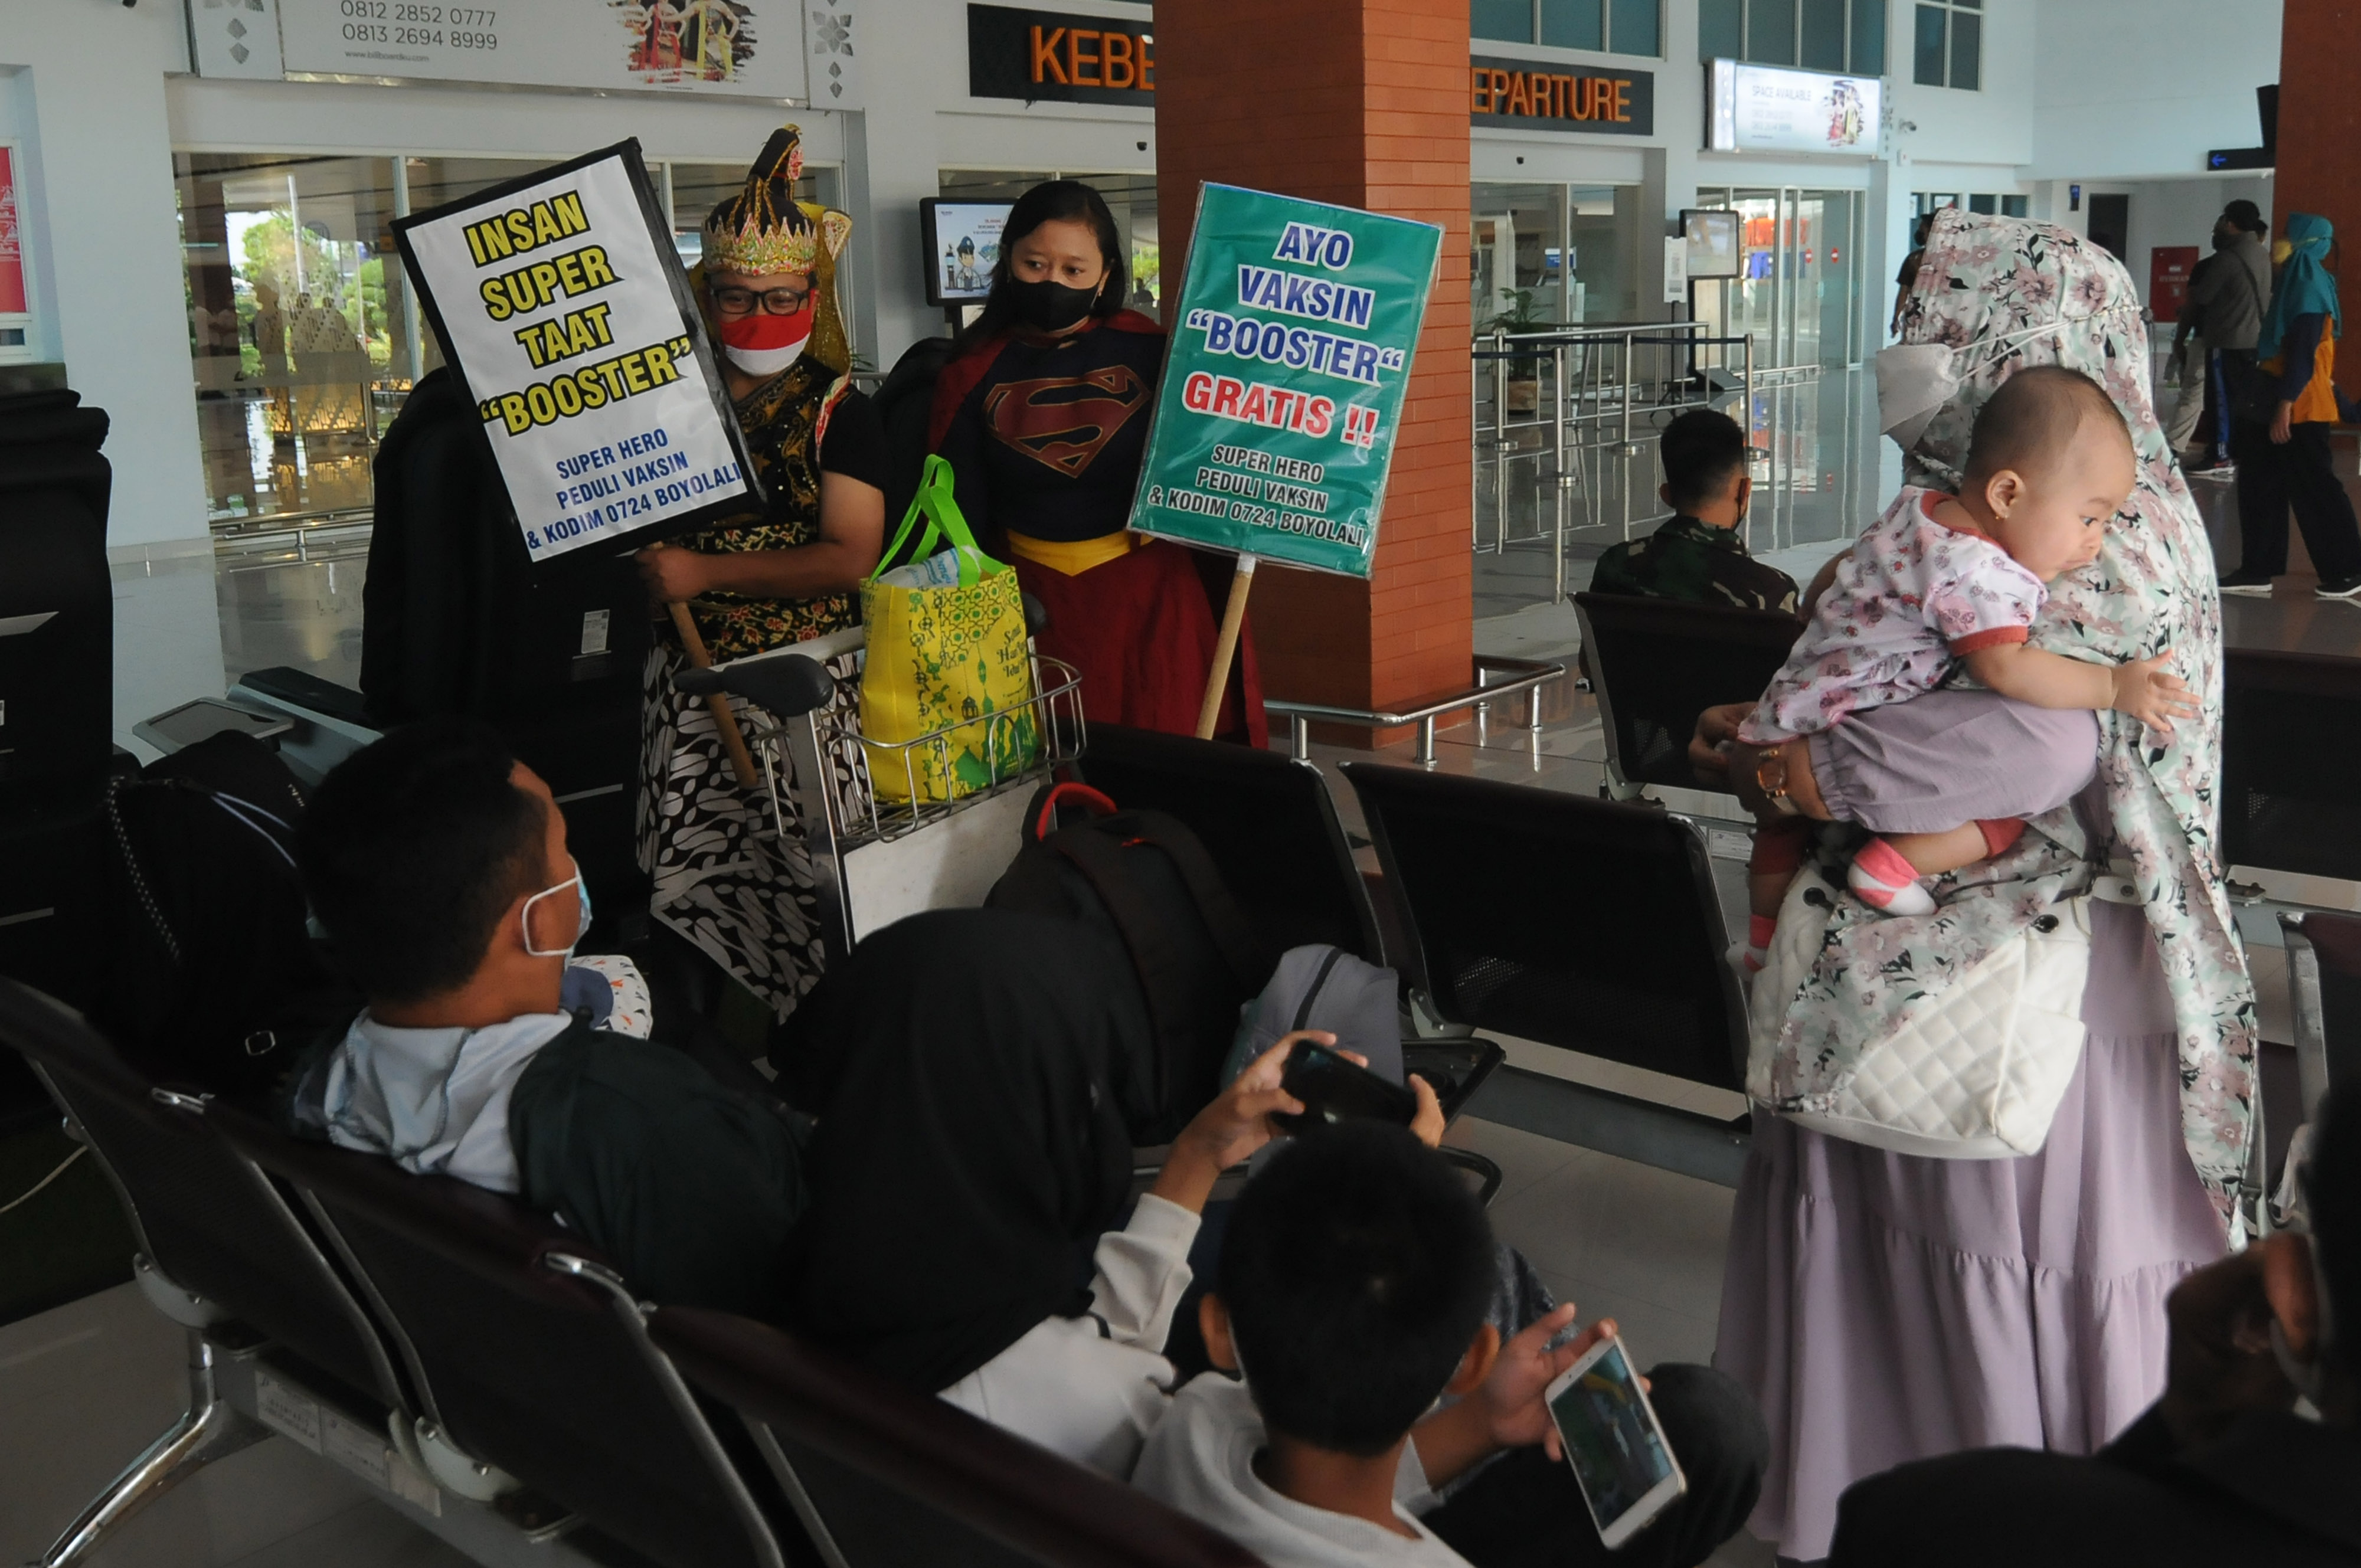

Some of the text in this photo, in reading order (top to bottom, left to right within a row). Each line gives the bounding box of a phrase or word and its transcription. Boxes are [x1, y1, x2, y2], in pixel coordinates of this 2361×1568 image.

[341, 0, 496, 27] 0812 2852 0777
[342, 23, 498, 50] 0813 2694 8999
[1030, 25, 1155, 90] KEBE
[1470, 67, 1631, 123] EPARTURE
[462, 190, 591, 268] INSAN
[1273, 221, 1353, 271] AYO
[480, 245, 615, 321] SUPER
[1238, 264, 1375, 330] VAKSIN
[514, 302, 614, 369] TAAT
[1182, 371, 1379, 450] GRATIS !!
[556, 428, 668, 479] SUPER HERO
[556, 450, 688, 509] PEDULI VAKSIN
[1211, 444, 1324, 484] SUPER HERO
[528, 462, 743, 549] & KODIM 0724 BOYOLALI
[1147, 485, 1365, 547] & KODIM 0724 BOYOLALI
[1195, 466, 1328, 513] PEDULI VAKSIN
